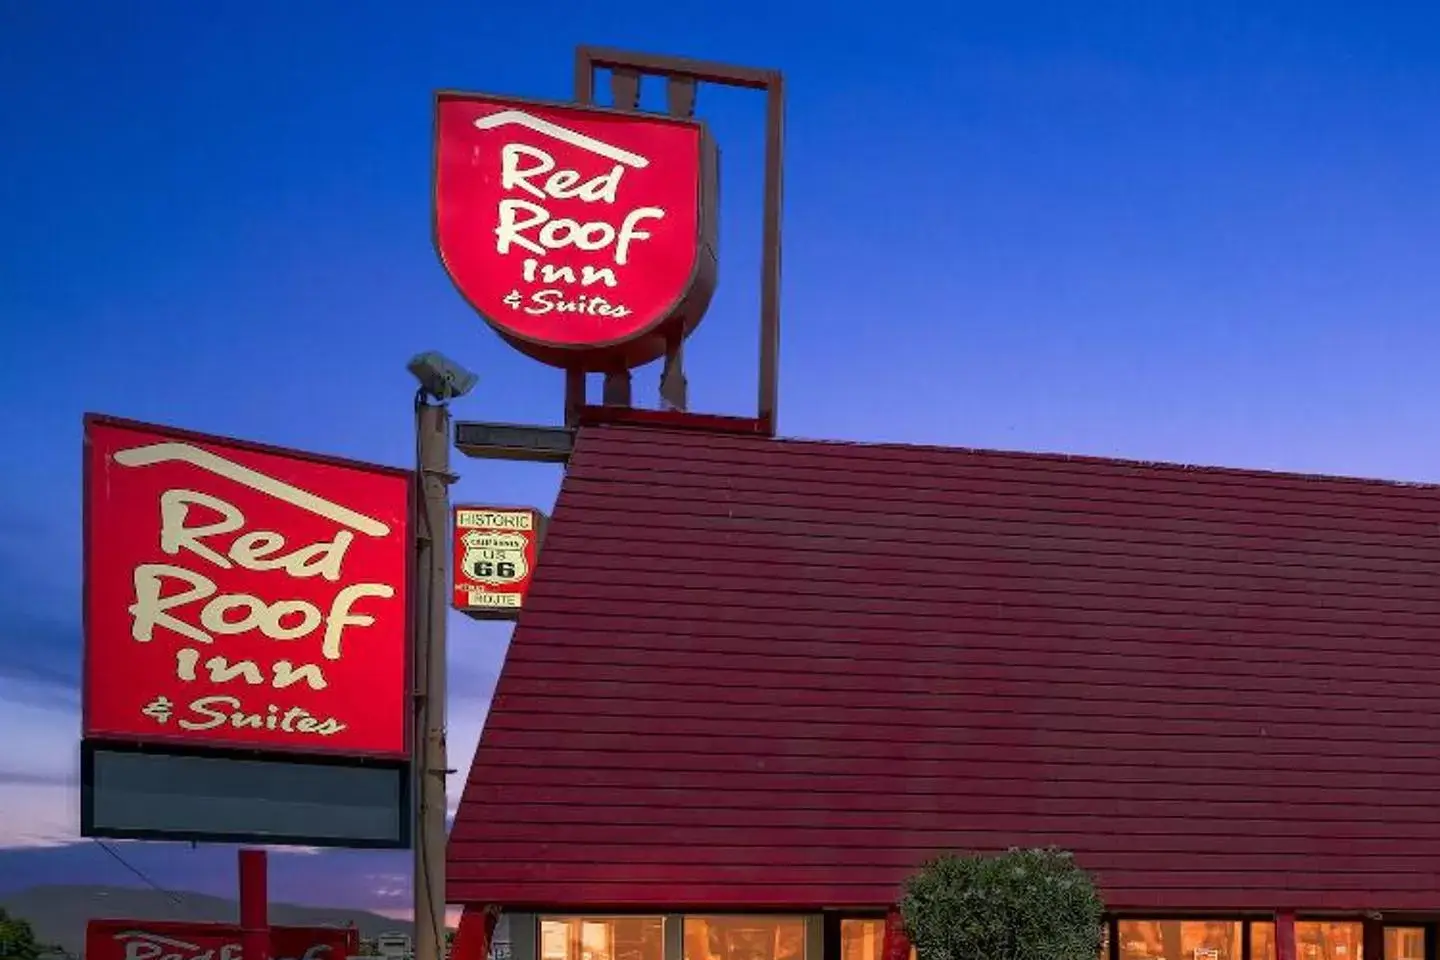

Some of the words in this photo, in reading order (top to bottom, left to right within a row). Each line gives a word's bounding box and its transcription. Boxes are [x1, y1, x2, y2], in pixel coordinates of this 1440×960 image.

[502, 143, 625, 204] Red
[495, 199, 666, 265] Roof
[523, 259, 618, 288] Inn
[502, 289, 523, 310] &
[524, 289, 633, 318] Suites
[160, 489, 354, 582] Red
[460, 513, 530, 528] HISTORIC
[474, 562, 516, 578] 66
[128, 563, 395, 660] Roof
[177, 648, 328, 690] Inn
[142, 696, 173, 727] &
[179, 696, 347, 736] Suites
